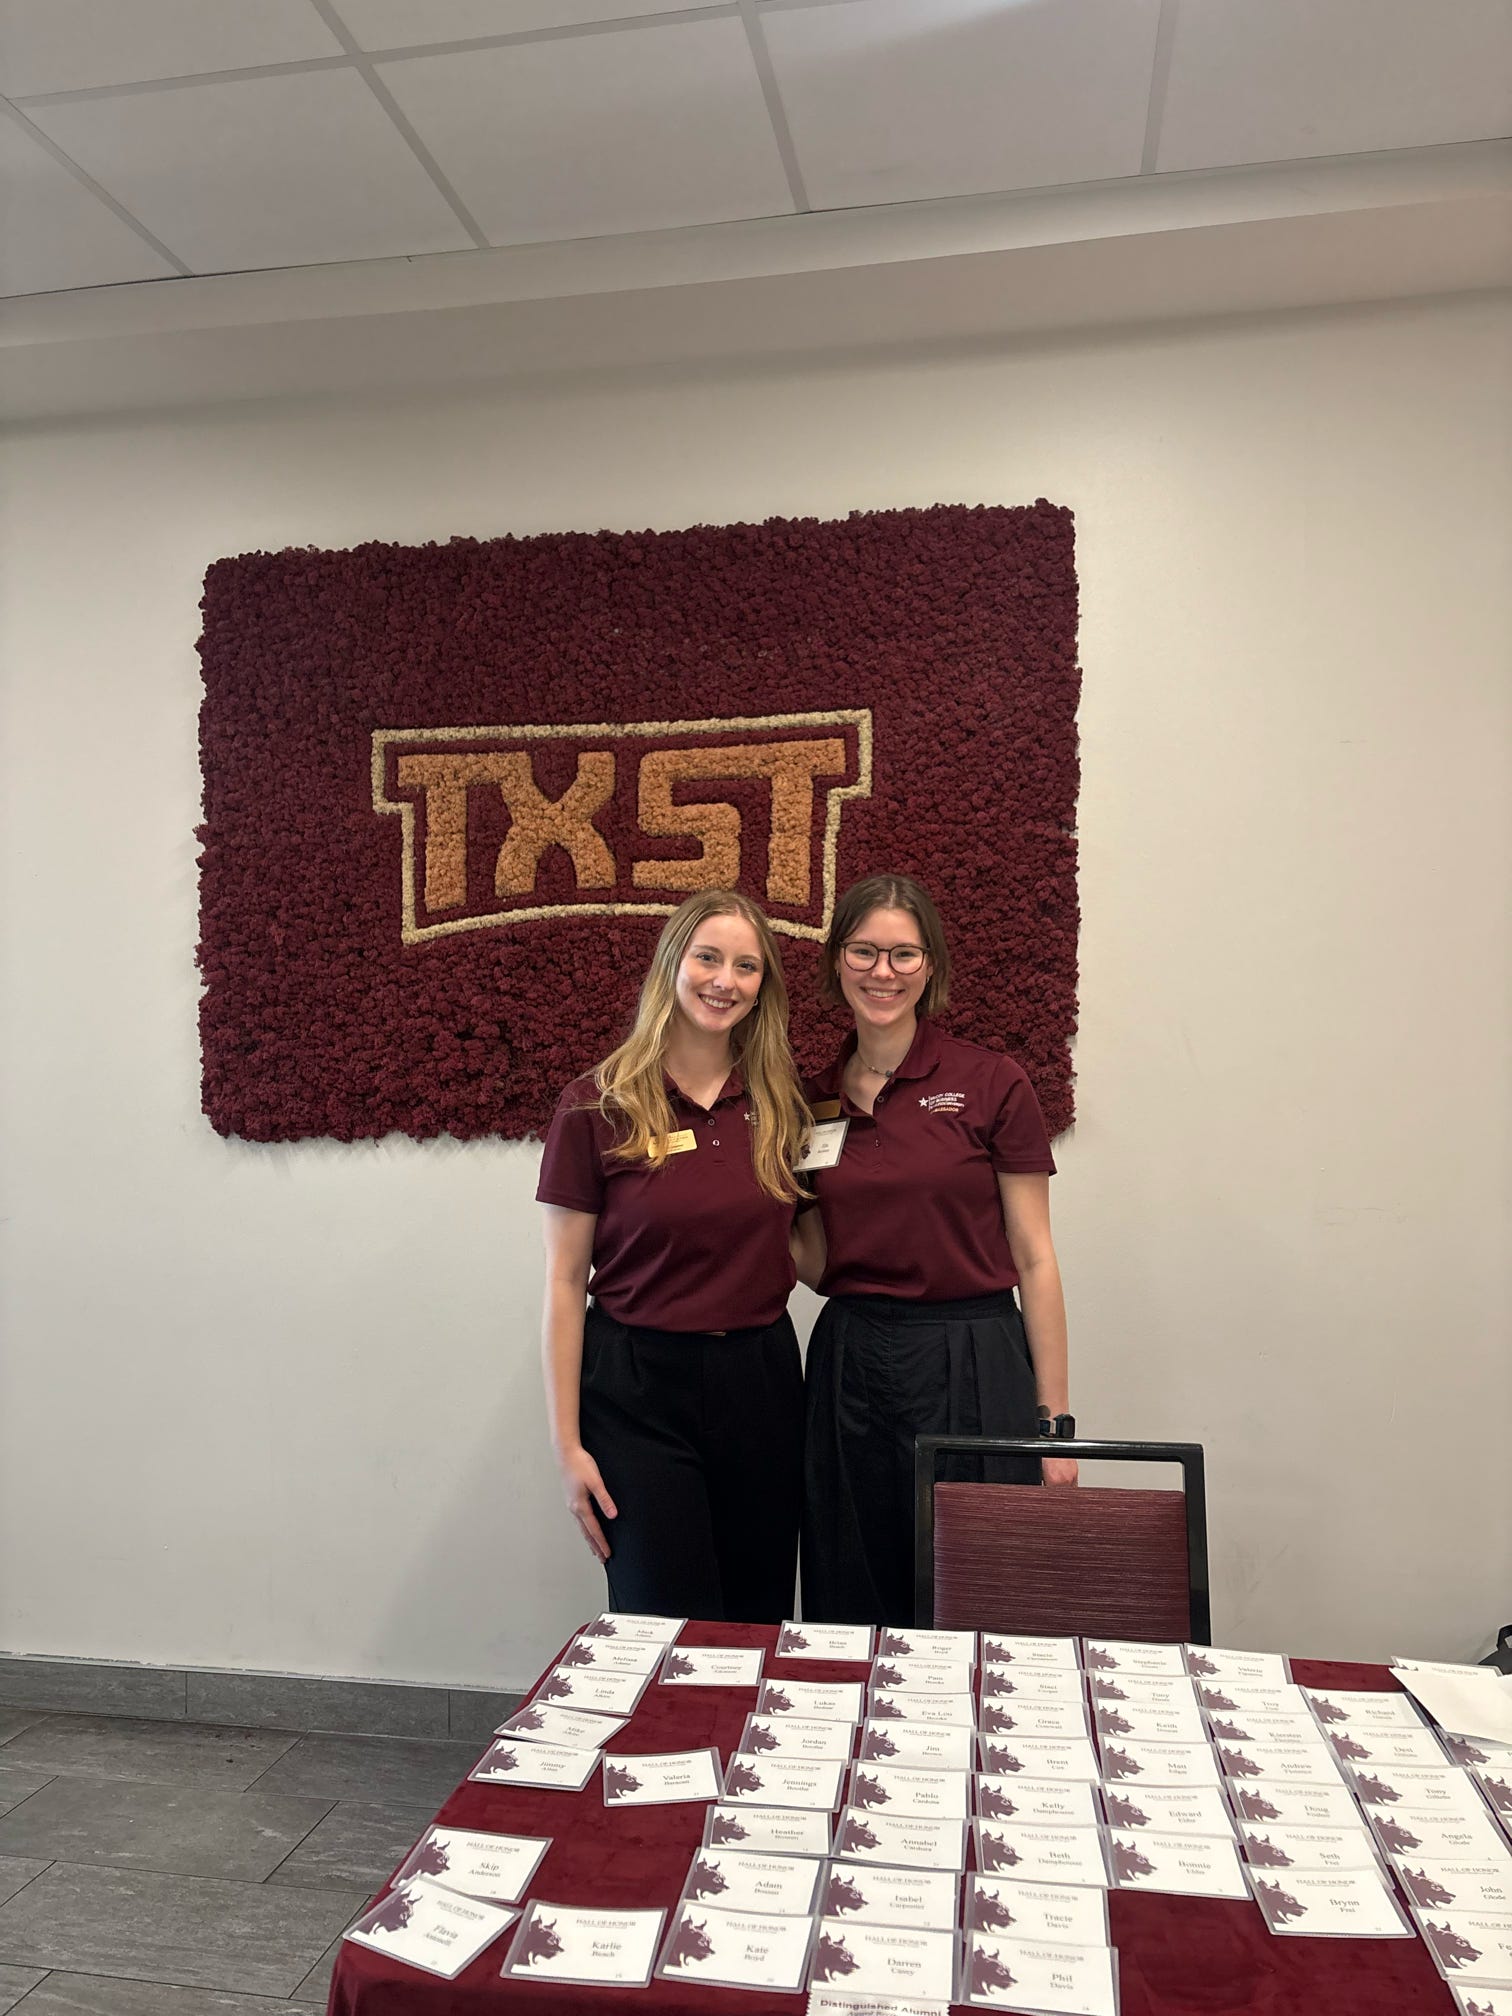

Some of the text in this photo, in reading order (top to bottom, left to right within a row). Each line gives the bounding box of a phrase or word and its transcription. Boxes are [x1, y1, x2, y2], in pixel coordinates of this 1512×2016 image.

[397, 737, 847, 914] TXST
[801, 1738, 827, 1746] Jordan
[781, 1778, 817, 1788] Jennings
[915, 1791, 939, 1799] Pablo
[1041, 1802, 1065, 1811] Kelly
[1168, 1810, 1202, 1818] Edward
[770, 1828, 804, 1836] Heather
[1441, 1833, 1473, 1841] Angela
[900, 1838, 938, 1847] Annabel
[480, 1861, 500, 1872] Skip
[755, 1880, 783, 1890] Adam
[1479, 1885, 1504, 1894] John
[895, 1894, 923, 1904] Isabel
[1044, 1912, 1073, 1923] Tracie
[591, 1941, 622, 1951] Karlie
[746, 1944, 769, 1955] Kate
[887, 1957, 922, 1969] Darren
[1051, 1972, 1073, 1983] Phil
[819, 1999, 898, 2010] Distinguished
[900, 2007, 942, 2016] Alumni
